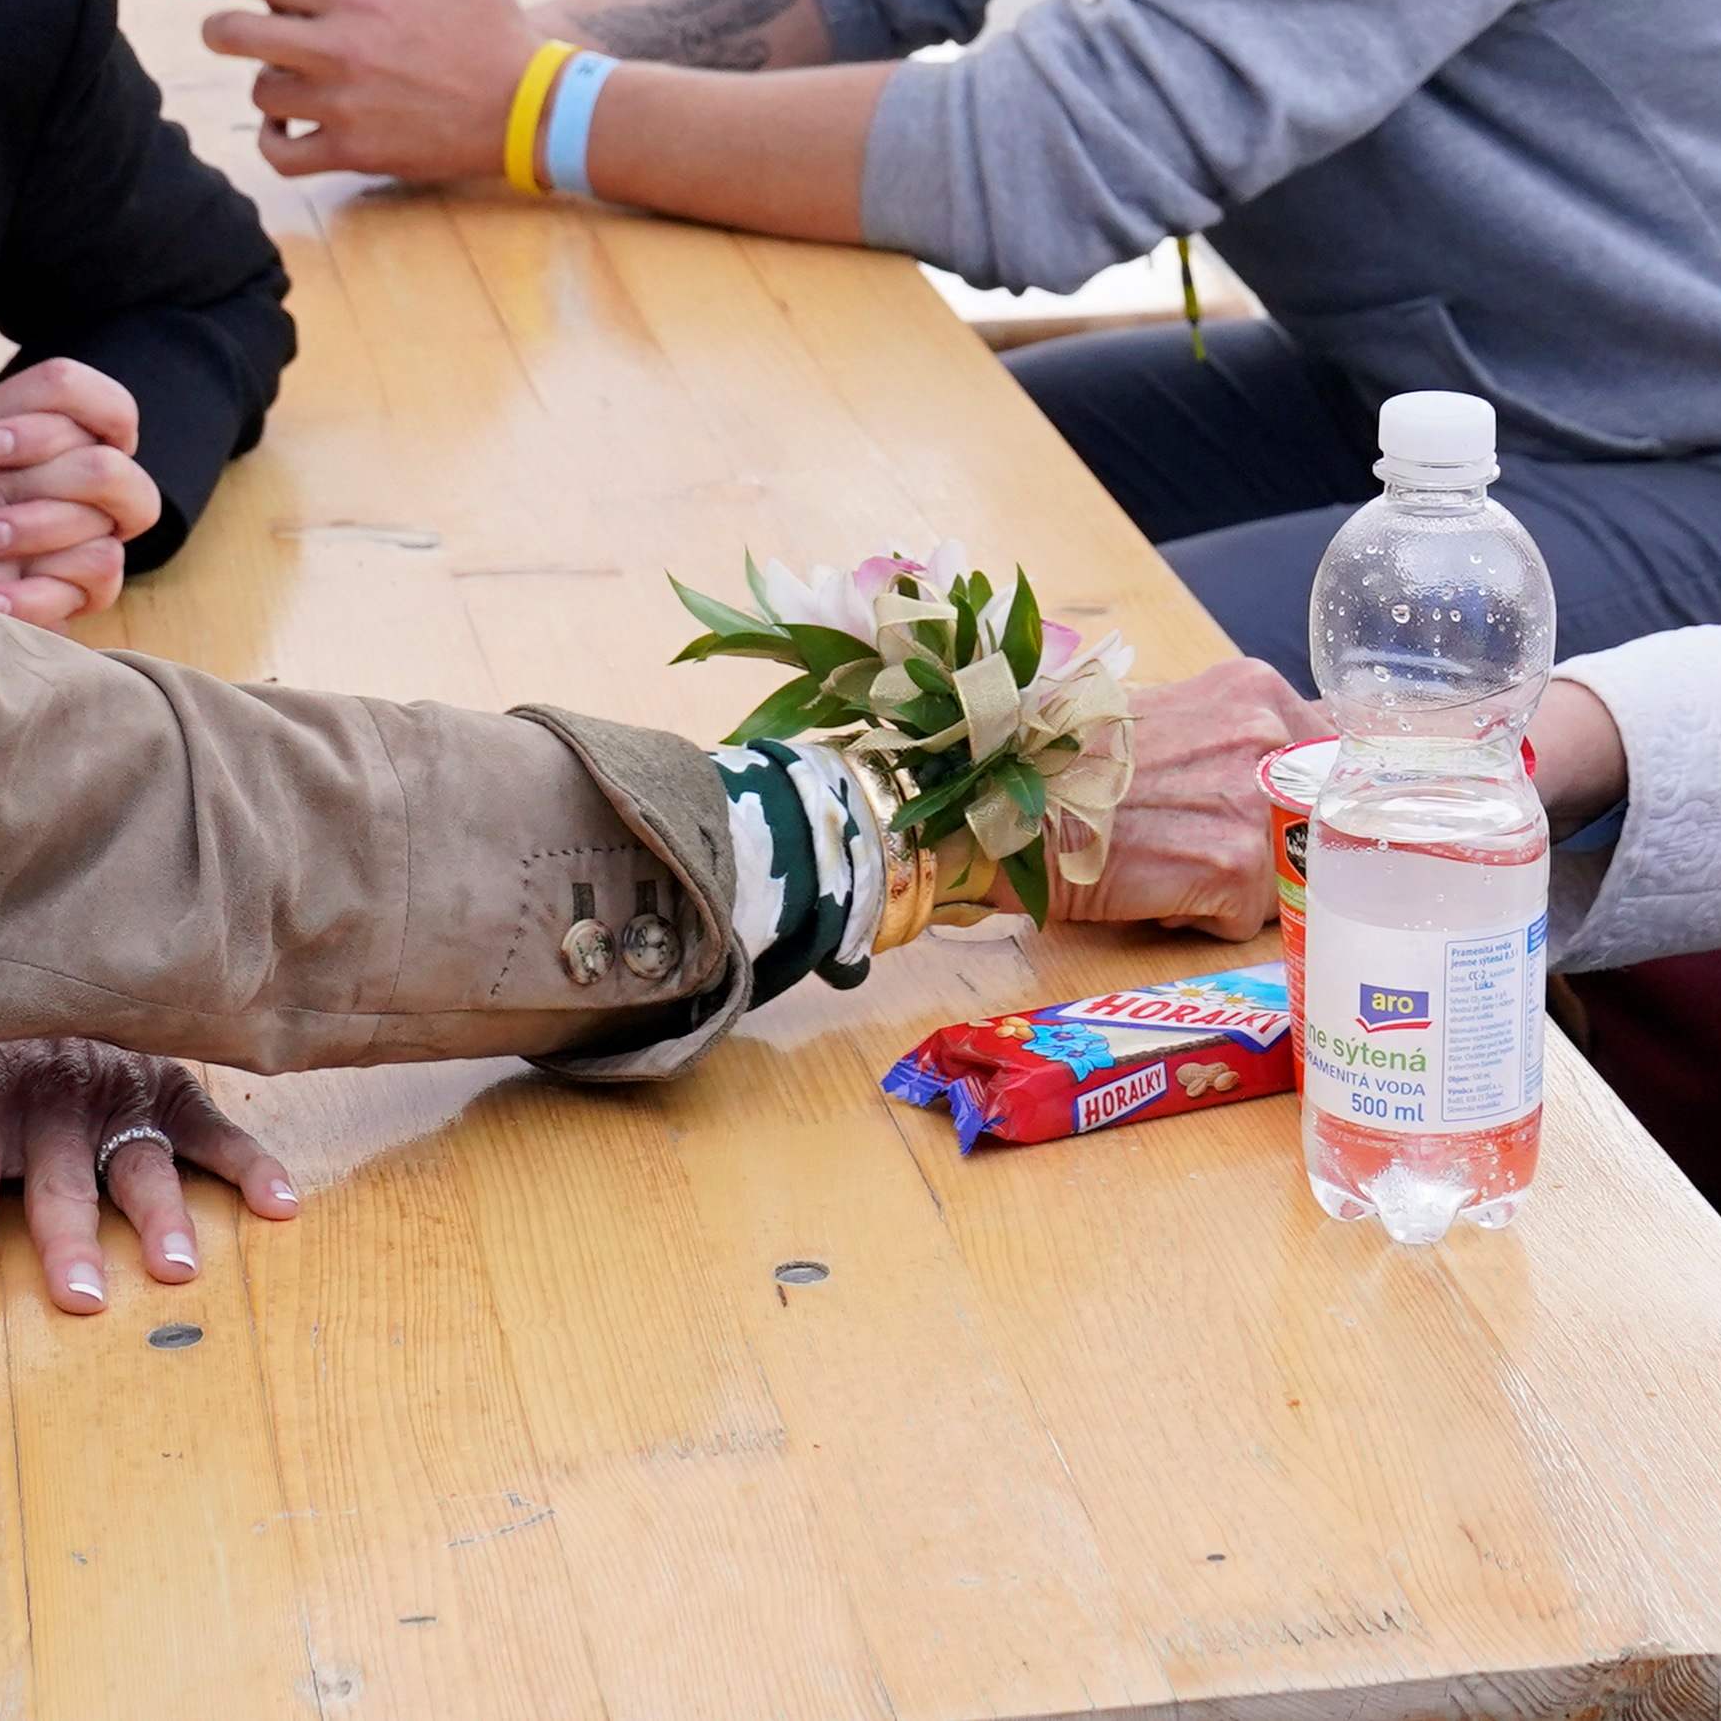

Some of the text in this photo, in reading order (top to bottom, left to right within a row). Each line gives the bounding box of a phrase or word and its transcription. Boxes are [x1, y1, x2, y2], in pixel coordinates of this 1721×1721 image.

[1083, 993, 1286, 1034] HORALKY
[1372, 992, 1415, 1014] aro
[1333, 1037, 1427, 1072] sýtená
[1084, 1068, 1163, 1127] HORALKY
[1375, 1078, 1426, 1096] VODA
[1351, 1093, 1388, 1118] 500
[1394, 1103, 1425, 1123] ml
